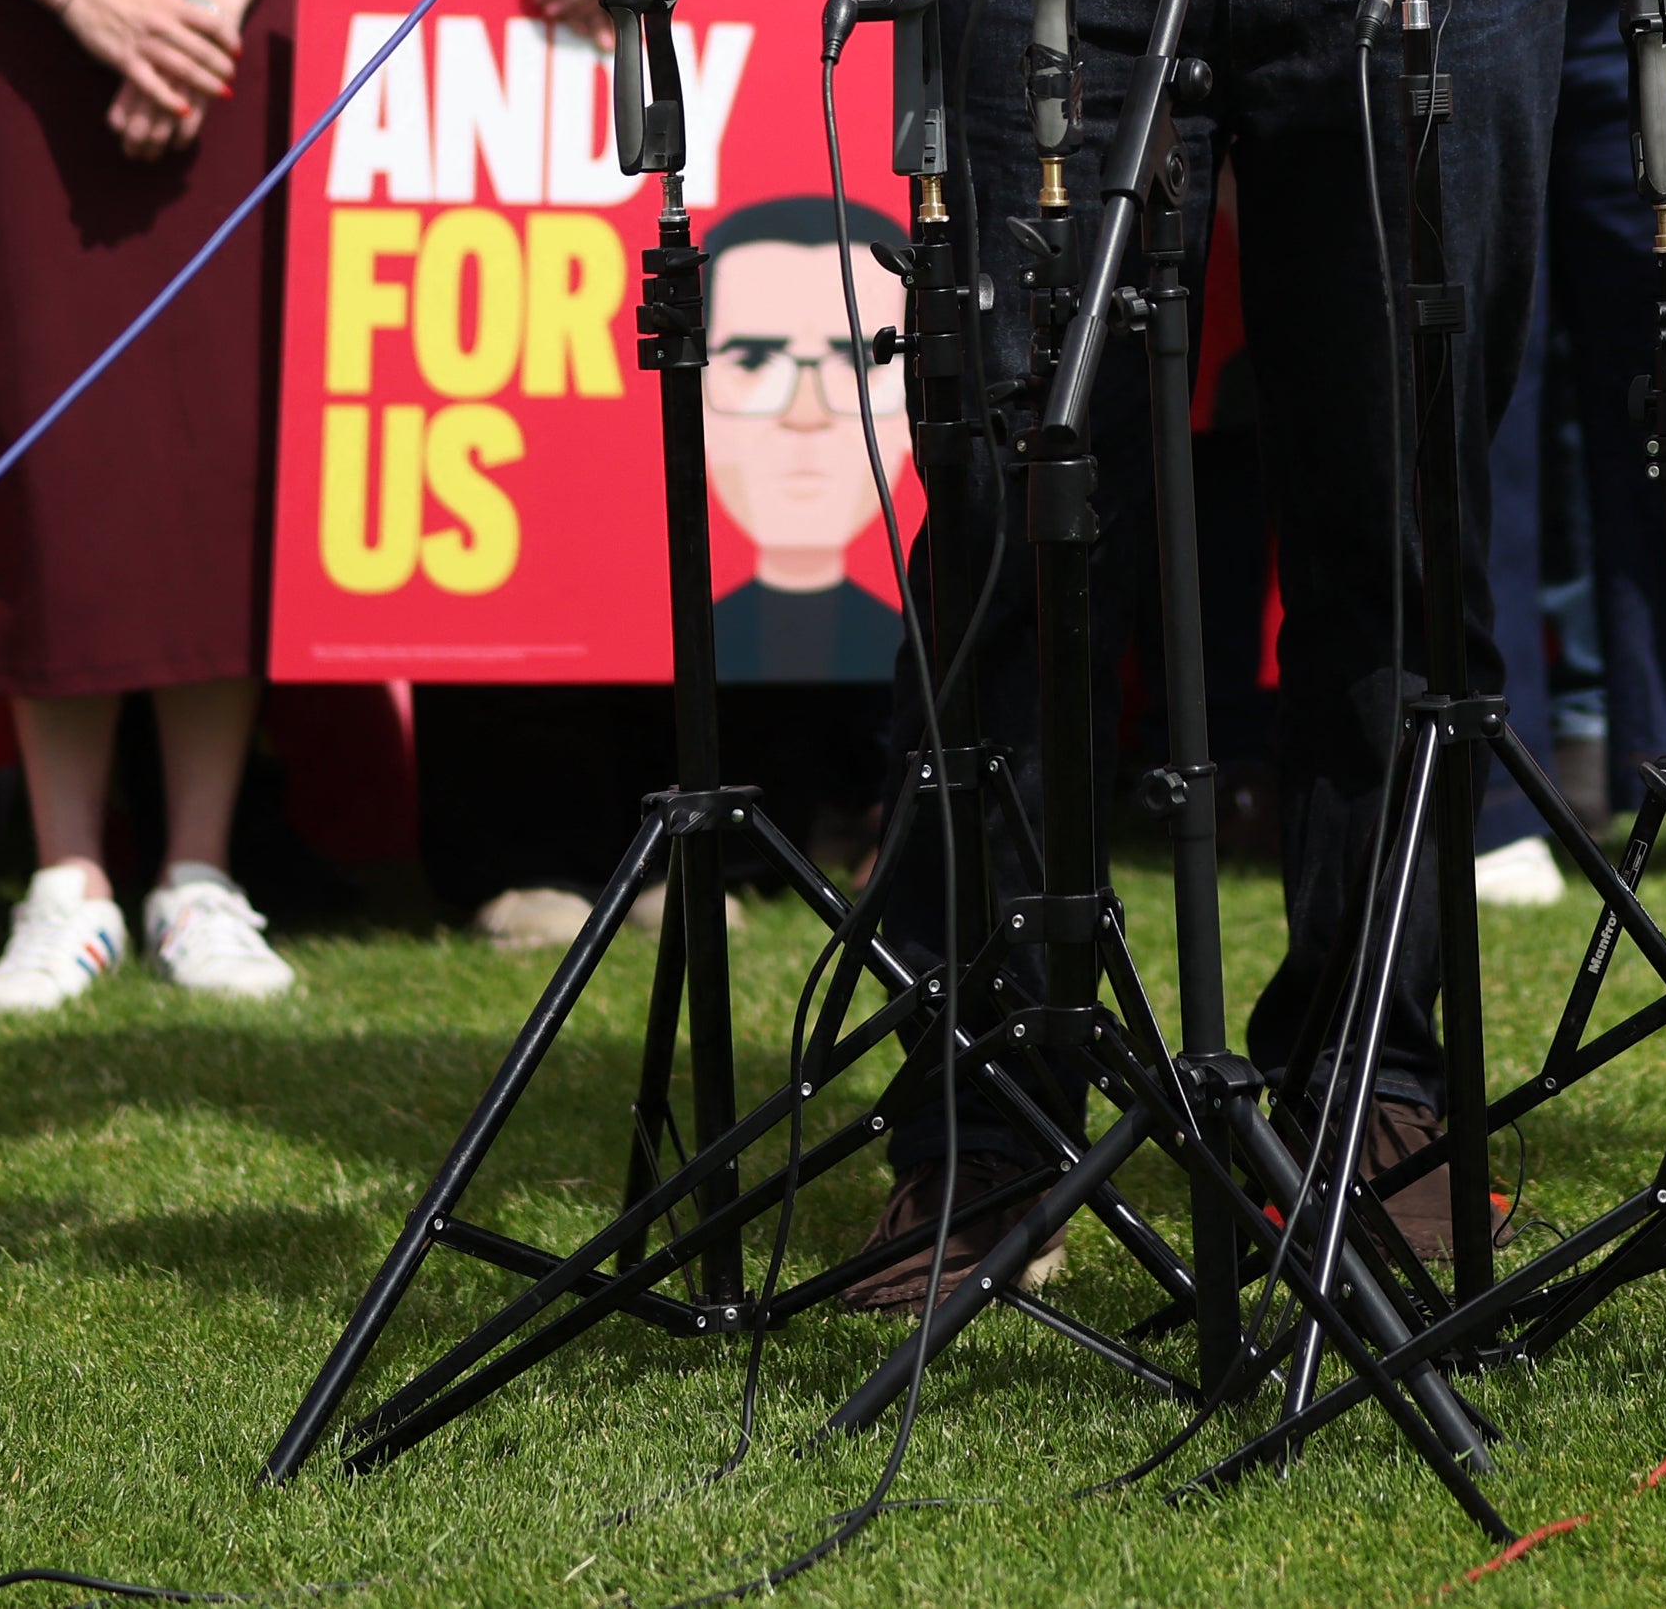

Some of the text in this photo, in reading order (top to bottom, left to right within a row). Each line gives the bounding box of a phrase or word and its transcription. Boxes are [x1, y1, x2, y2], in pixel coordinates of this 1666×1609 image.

[326, 13, 755, 208] ANDY
[324, 207, 625, 398] FOR
[318, 403, 525, 594] US
[1588, 910, 1617, 974] Manfro
